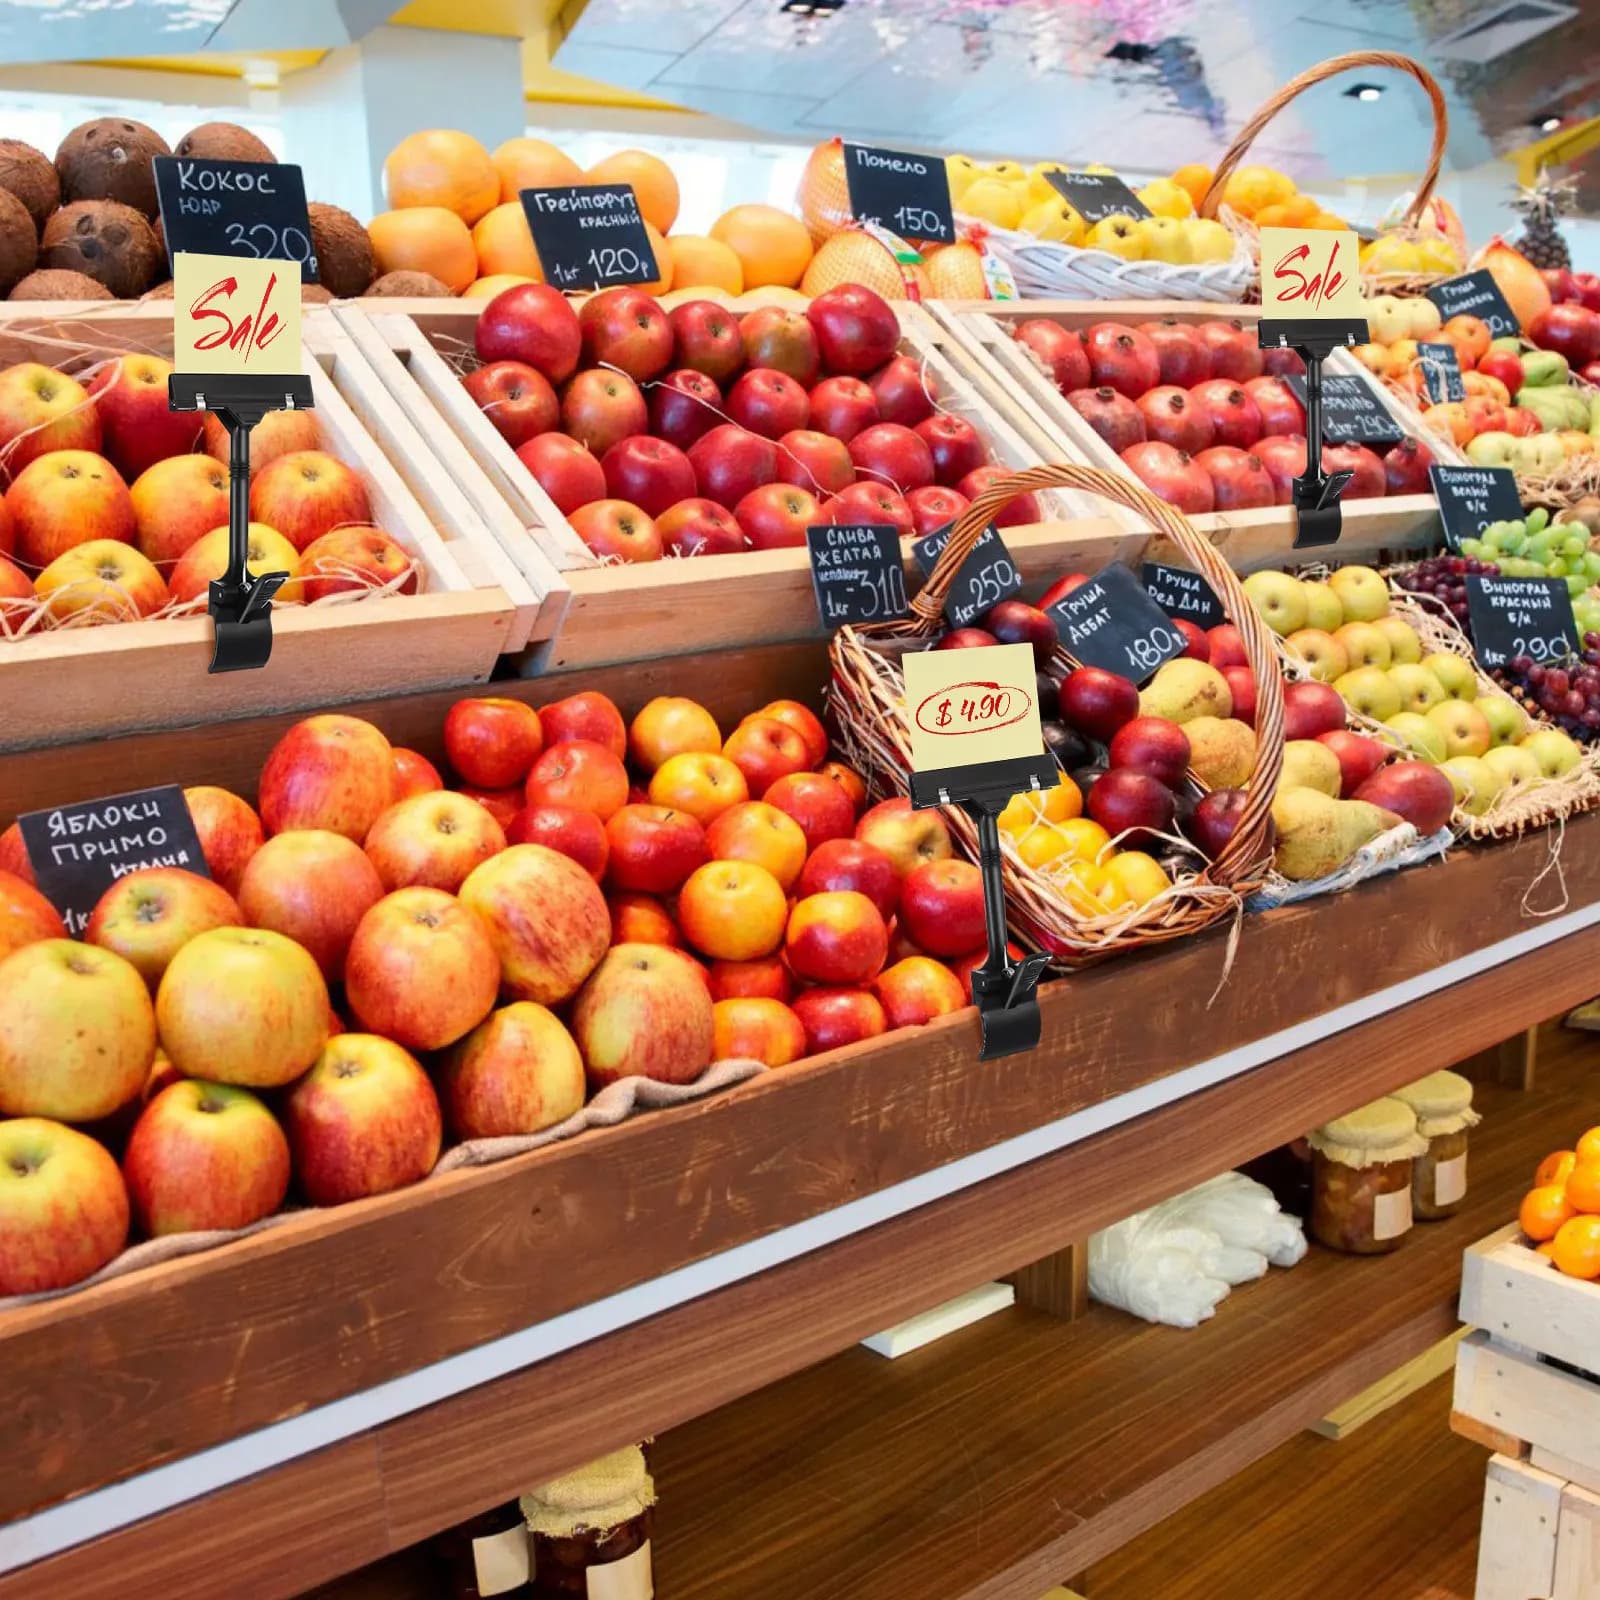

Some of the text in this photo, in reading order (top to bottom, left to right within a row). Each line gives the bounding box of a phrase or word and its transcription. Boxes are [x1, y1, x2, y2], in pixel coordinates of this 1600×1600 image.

[856, 149, 927, 175] Помело
[1274, 240, 1349, 312] Sale
[190, 272, 288, 364] Sale
[826, 528, 876, 546] СЛИВА
[815, 545, 882, 567] ЖЕЛТАЯ
[1068, 607, 1112, 645] АББАТ
[48, 801, 162, 838] ЯБЛОКИ
[51, 827, 167, 865] ПРИМО
